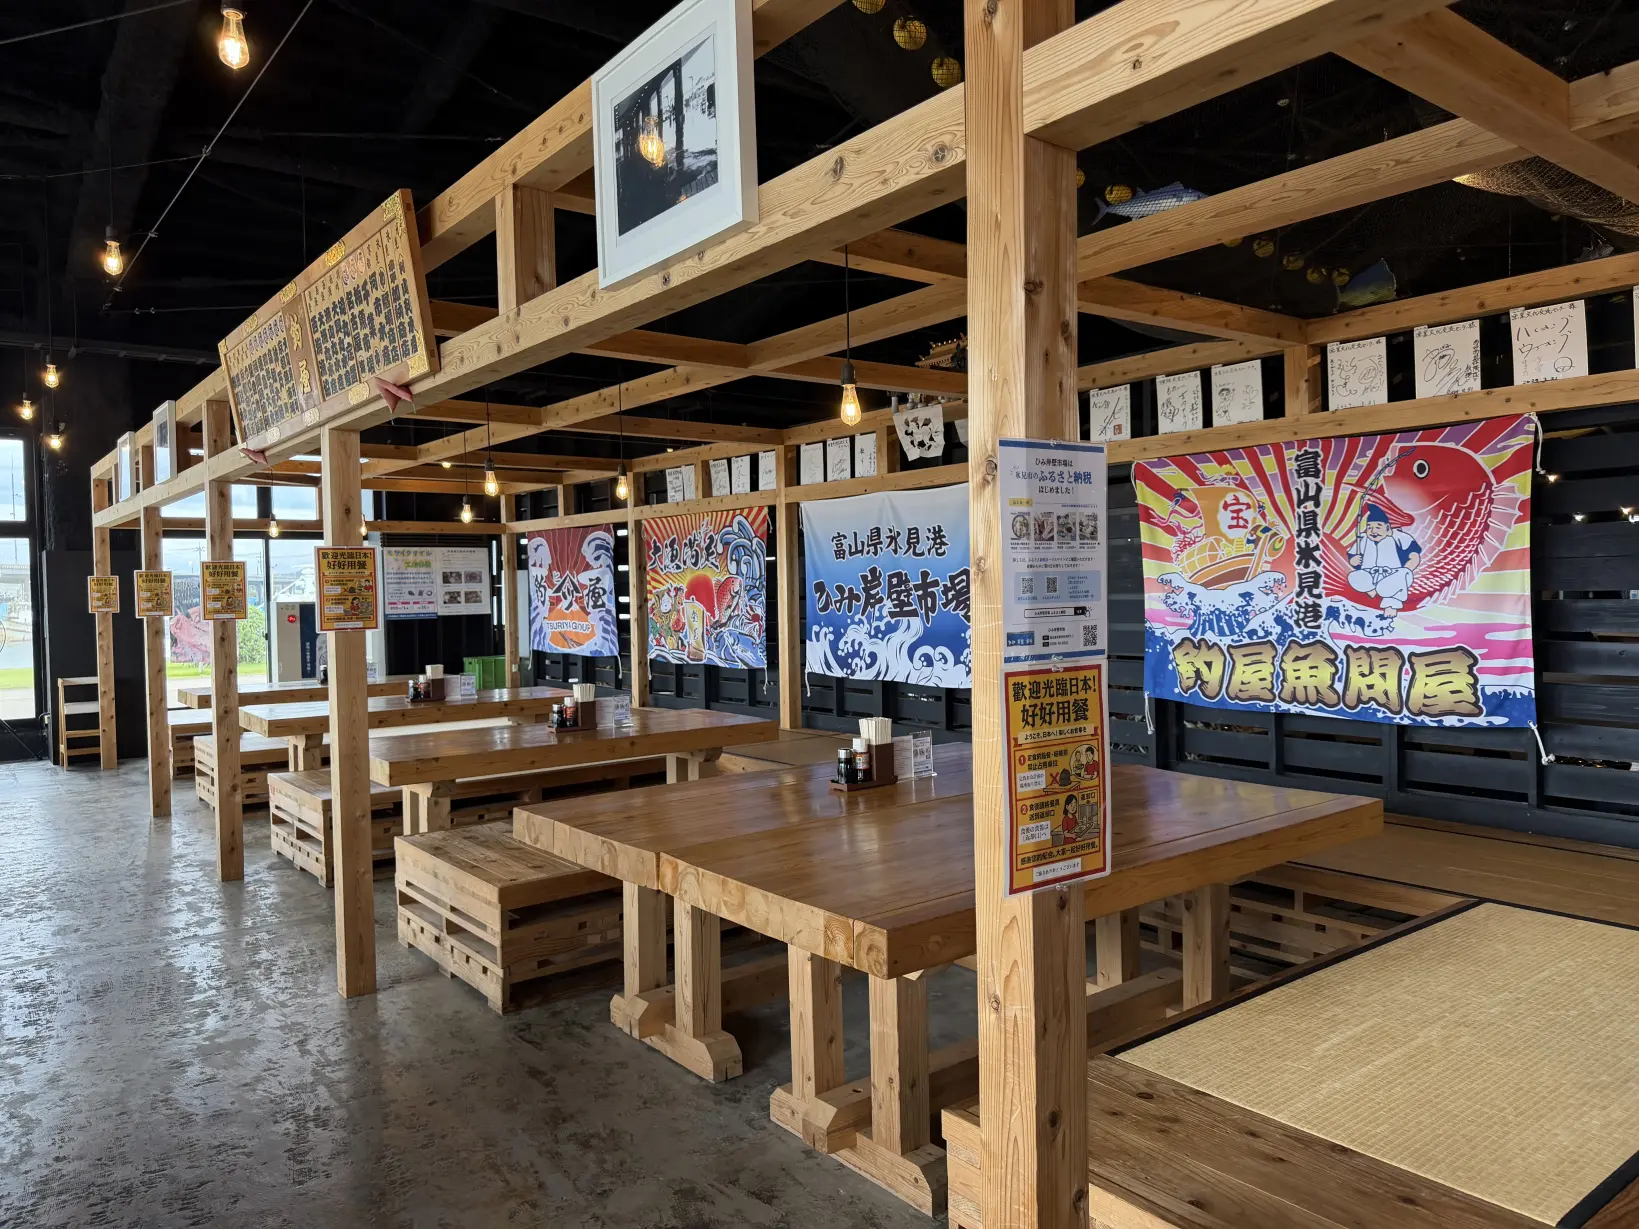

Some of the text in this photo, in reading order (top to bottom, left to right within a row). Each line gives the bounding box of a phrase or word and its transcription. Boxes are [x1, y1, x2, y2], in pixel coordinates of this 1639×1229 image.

[1015, 470, 1093, 485] 氷見市のふるさと納税
[1038, 485, 1074, 495] はじめました!
[1222, 493, 1250, 531] 宝
[830, 524, 950, 561] 富山県氷見港
[1293, 447, 1323, 630] 富山県氷見港
[813, 565, 970, 627] ひみ岸壁市場
[1011, 675, 1097, 702] 歡迎光臨日本!
[1171, 636, 1485, 718] 釣屋魚問屋
[1020, 697, 1090, 729] 好好用餐
